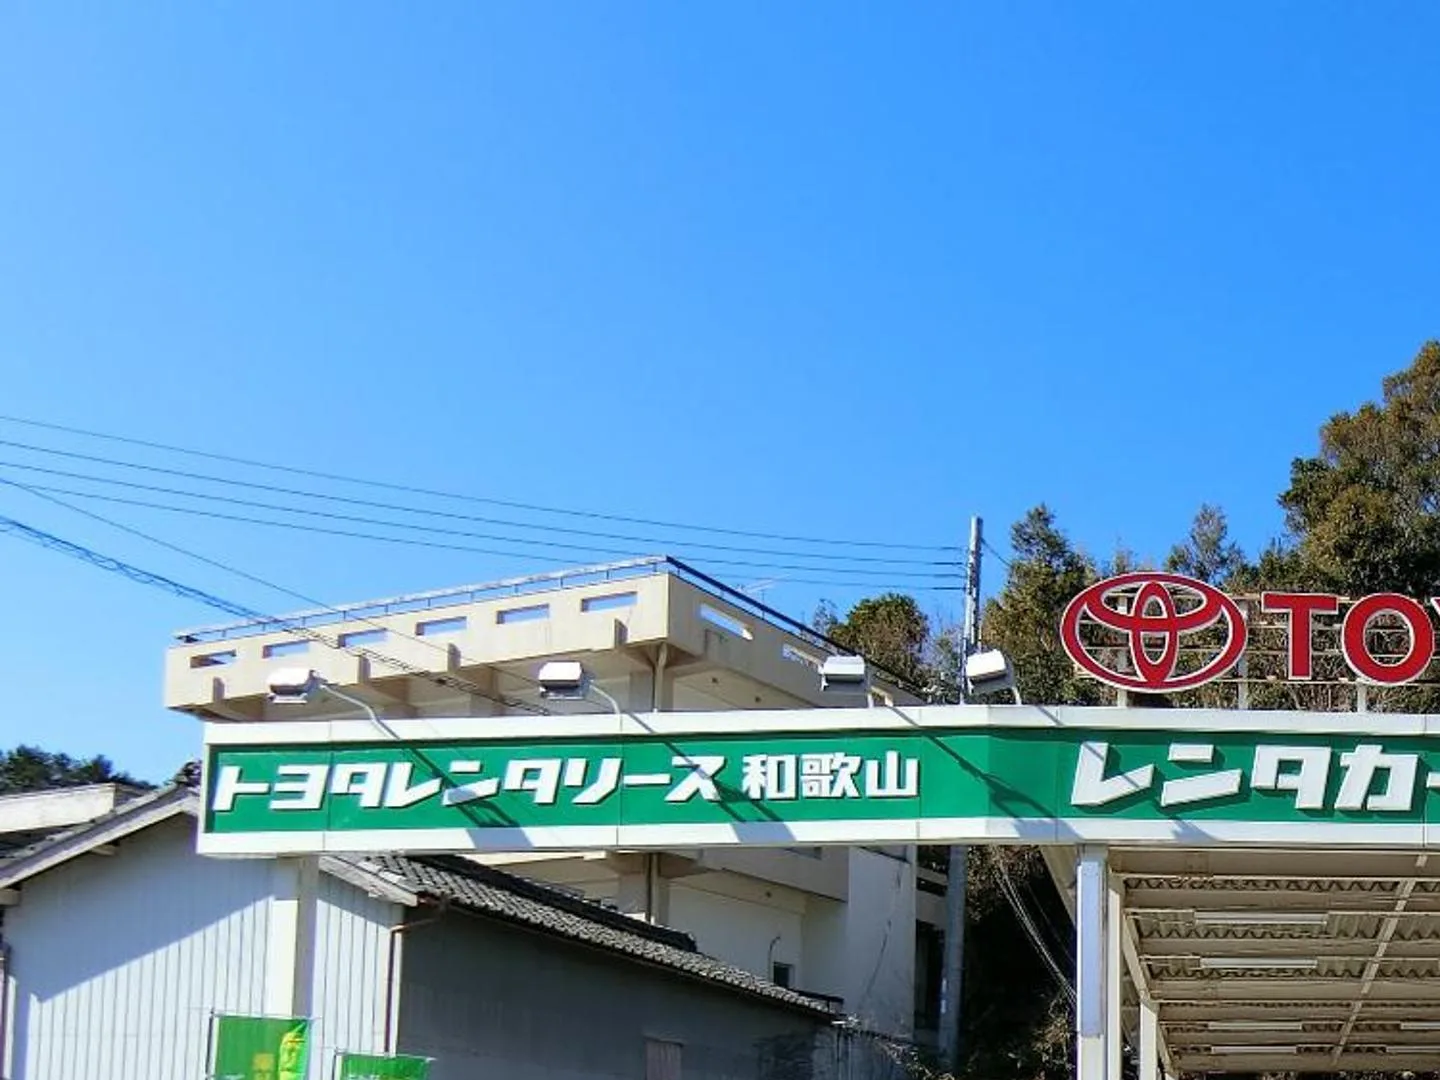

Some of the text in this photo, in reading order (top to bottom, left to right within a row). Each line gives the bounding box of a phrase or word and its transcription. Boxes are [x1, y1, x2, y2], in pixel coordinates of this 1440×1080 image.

[213, 751, 920, 812] トヨタレンタリース 和歌山
